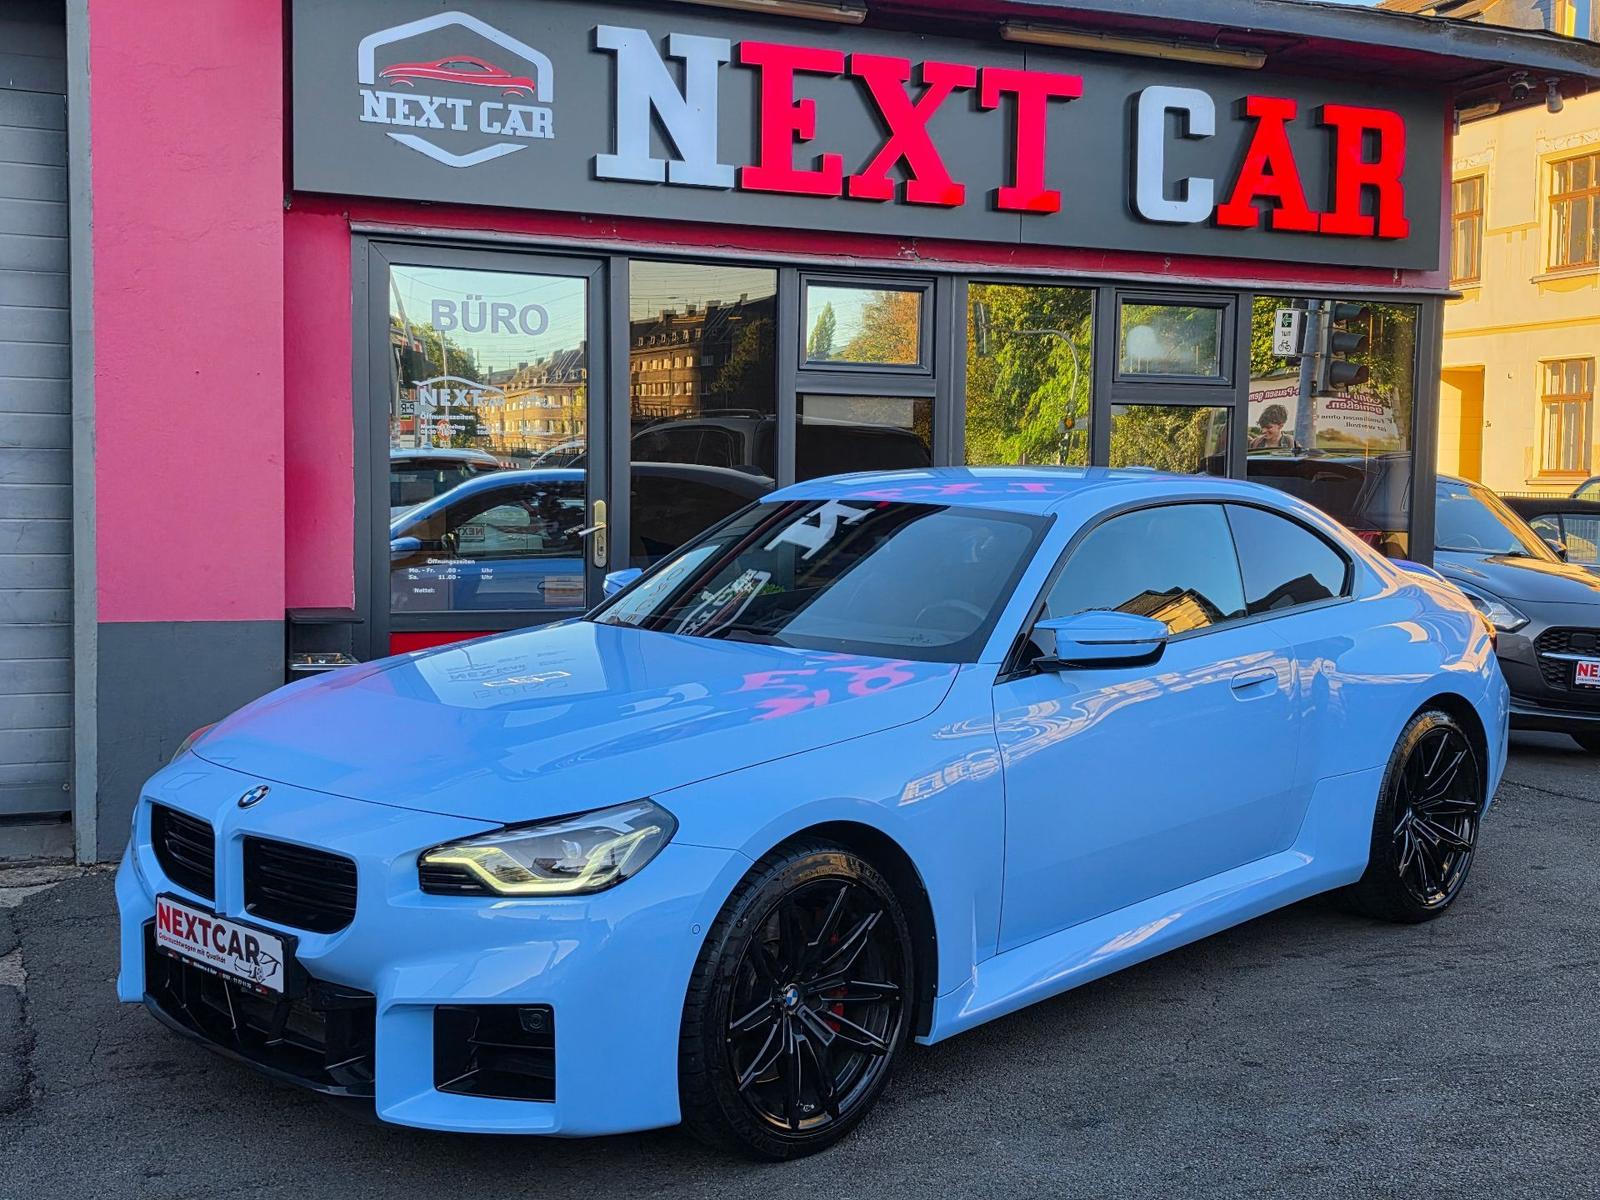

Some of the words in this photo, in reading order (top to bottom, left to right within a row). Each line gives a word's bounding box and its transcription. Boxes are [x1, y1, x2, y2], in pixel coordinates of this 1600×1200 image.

[358, 88, 473, 132] NEXT
[479, 101, 555, 140] CAR
[593, 24, 1083, 213] NEXT
[1129, 85, 1410, 240] CAR
[431, 294, 549, 336] BÜRO
[420, 389, 483, 407] NEXT
[427, 558, 476, 566] Öffnungszeiten
[1577, 662, 1600, 678] NE
[158, 902, 261, 966] NEXTCAR
